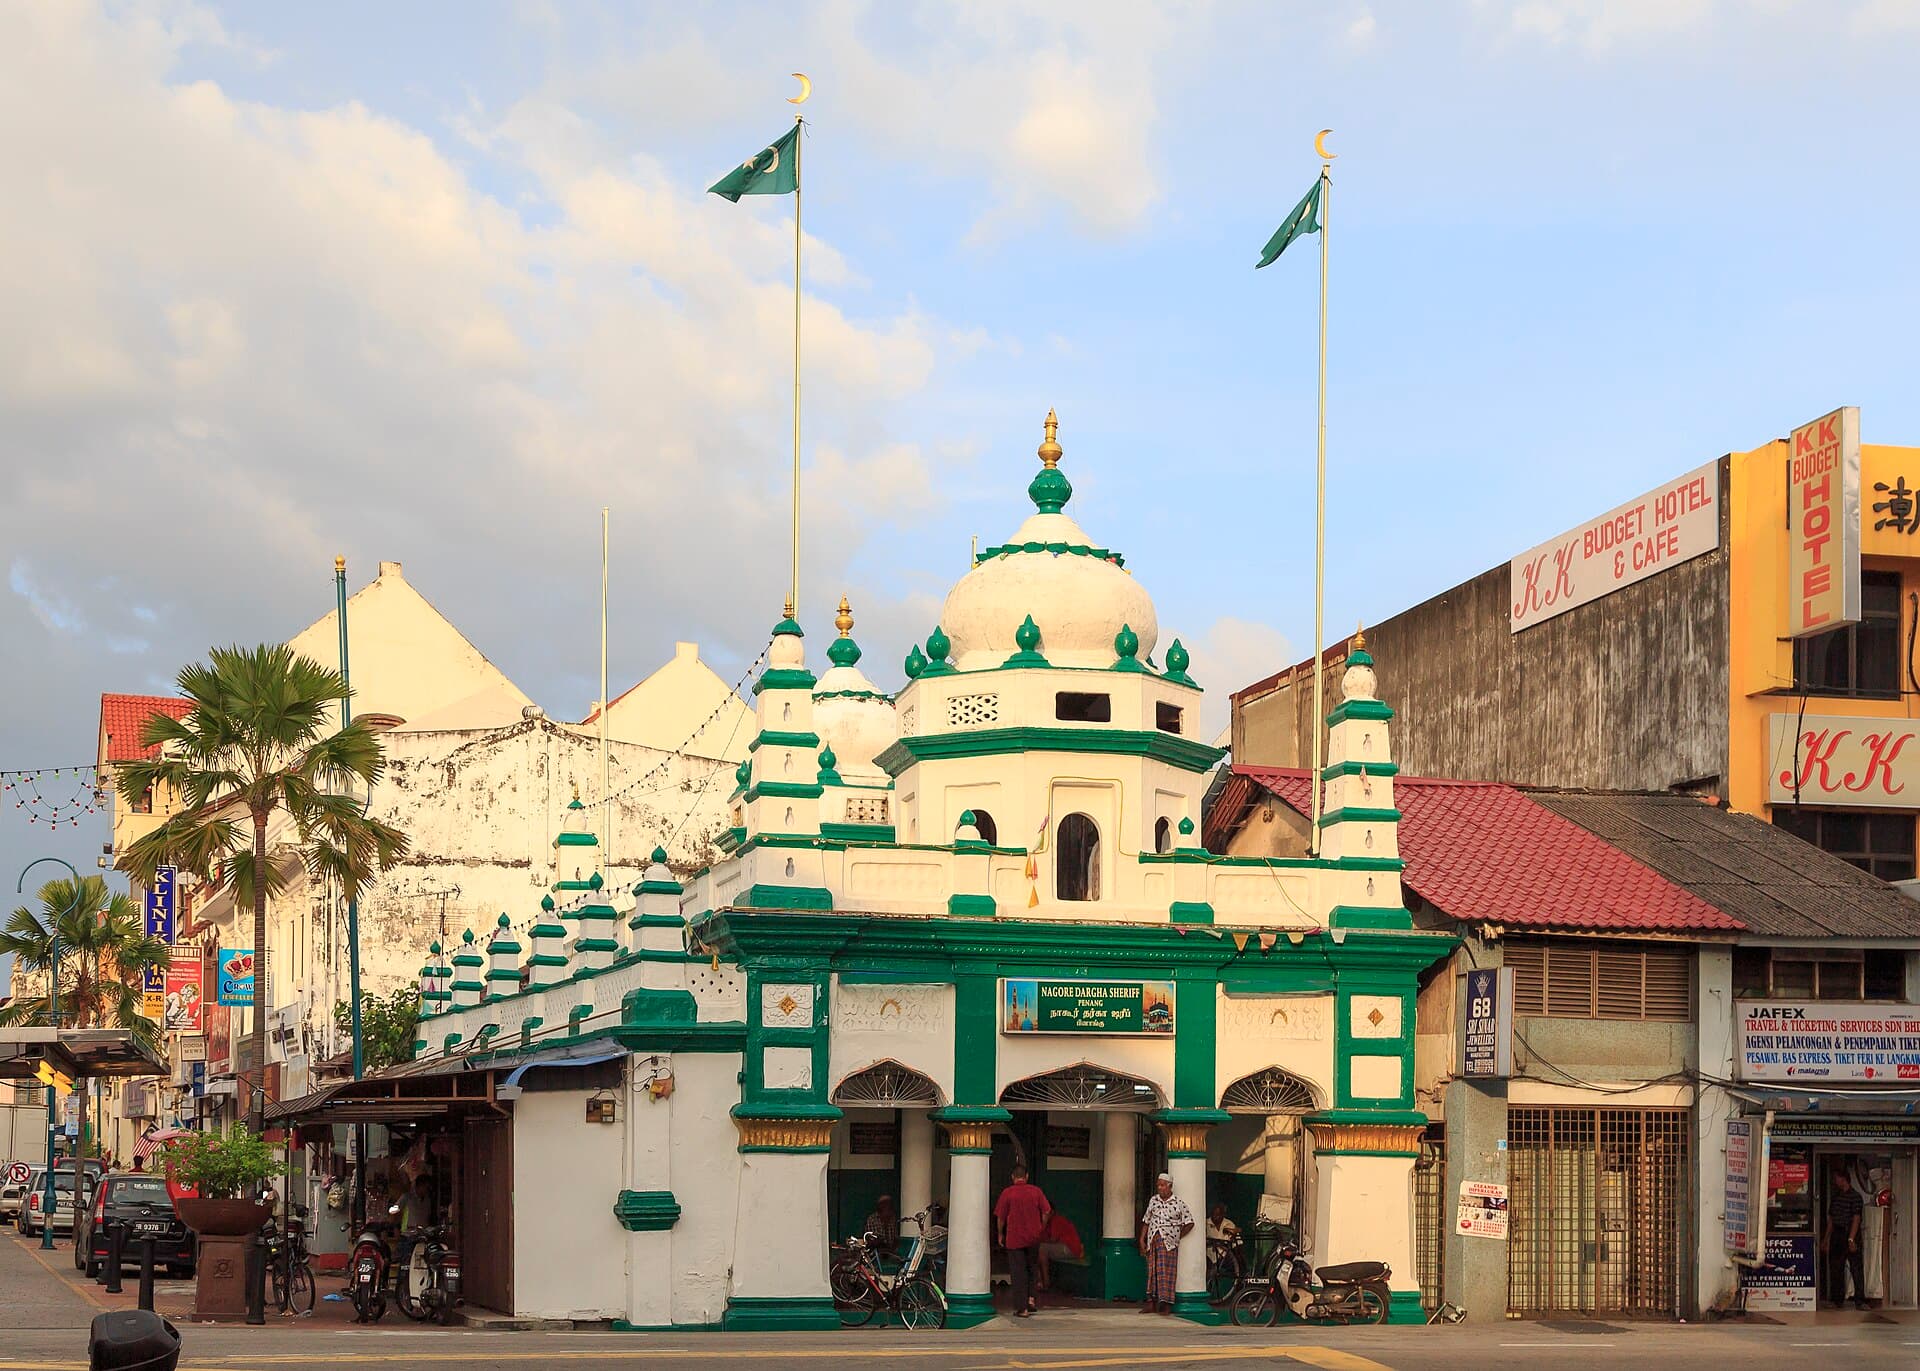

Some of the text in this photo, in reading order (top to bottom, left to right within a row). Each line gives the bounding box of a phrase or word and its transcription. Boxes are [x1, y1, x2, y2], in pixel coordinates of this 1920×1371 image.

[1793, 442, 1840, 485] BUDGET
[1584, 504, 1646, 560] BUDGET
[1655, 476, 1712, 527] HOTEL
[1614, 524, 1679, 580] & CAFE
[1803, 472, 1831, 628] HOTEL
[152, 870, 170, 944] KLINIK
[1041, 986, 1140, 998] NAGORE DARGHA SHERIFF
[1472, 997, 1491, 1018] 68
[1749, 1008, 1805, 1019] JAFEX
[1745, 1019, 1780, 1032] TRAVEL
[1781, 1020, 1788, 1032] &
[1790, 1020, 1837, 1032] TICKETING
[1840, 1020, 1883, 1033] SERVICES
[1885, 1020, 1902, 1033] SDN
[1745, 1035, 1774, 1049] AGENSI
[1775, 1036, 1833, 1049] PELANCONGAN
[1834, 1036, 1842, 1050] &
[1844, 1037, 1897, 1050] PENEMPAHAN
[1782, 1052, 1797, 1064] BAS
[1834, 1052, 1856, 1064] TIKET
[1857, 1053, 1874, 1065] FERI
[1875, 1053, 1885, 1065] KE
